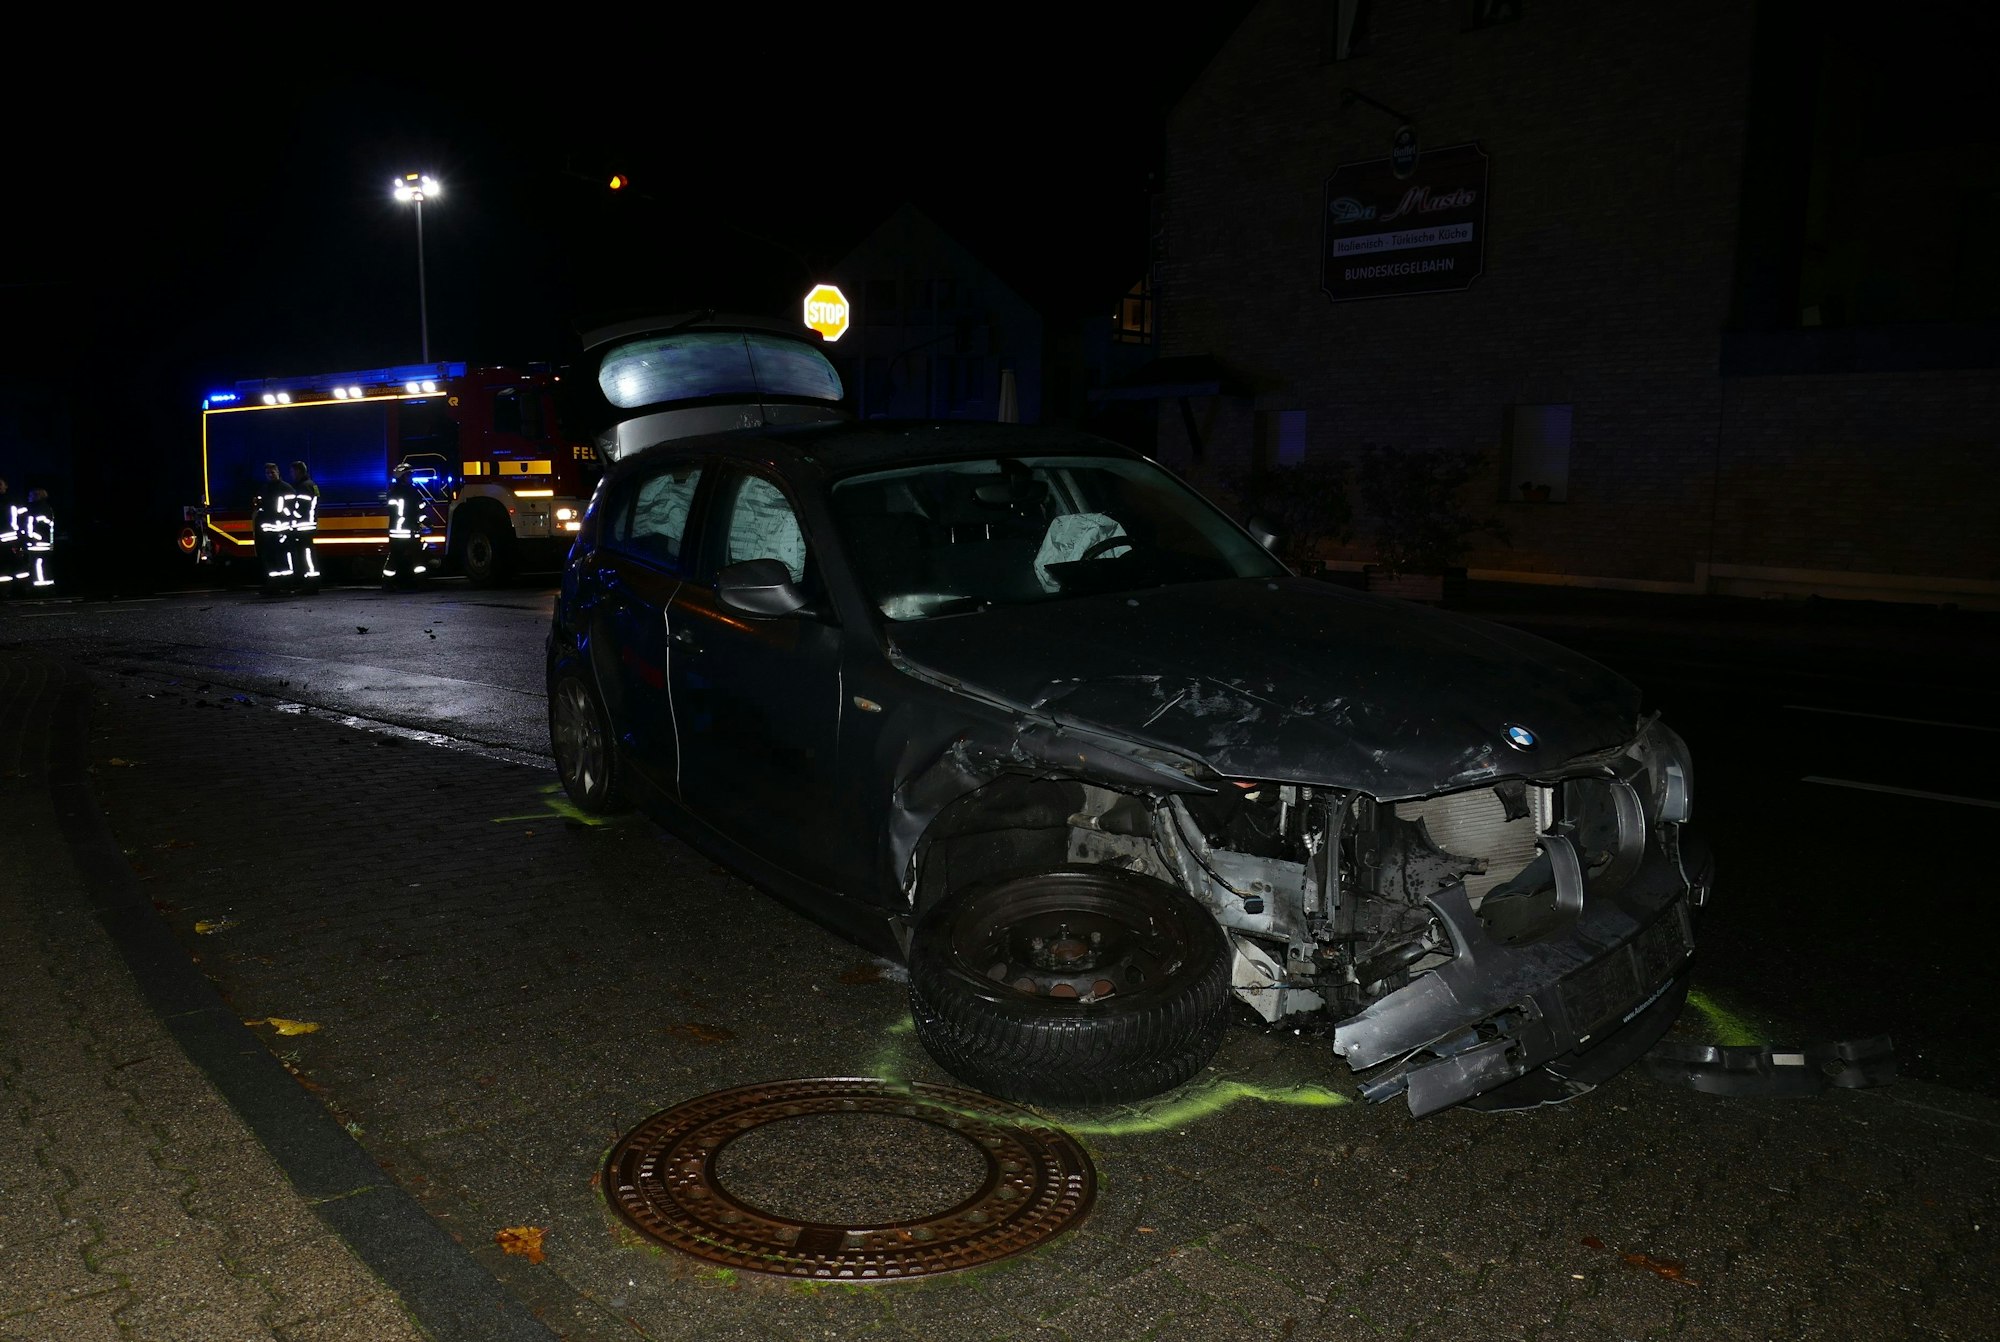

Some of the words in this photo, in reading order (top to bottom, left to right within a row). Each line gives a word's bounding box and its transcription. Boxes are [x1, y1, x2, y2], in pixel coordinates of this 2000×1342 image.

[1337, 236, 1384, 252] Italienisch
[1391, 232, 1435, 246] Türkische
[1438, 228, 1468, 241] Küche
[1345, 257, 1454, 281] BUNDESKEGELBAHN
[809, 302, 845, 325] STOP
